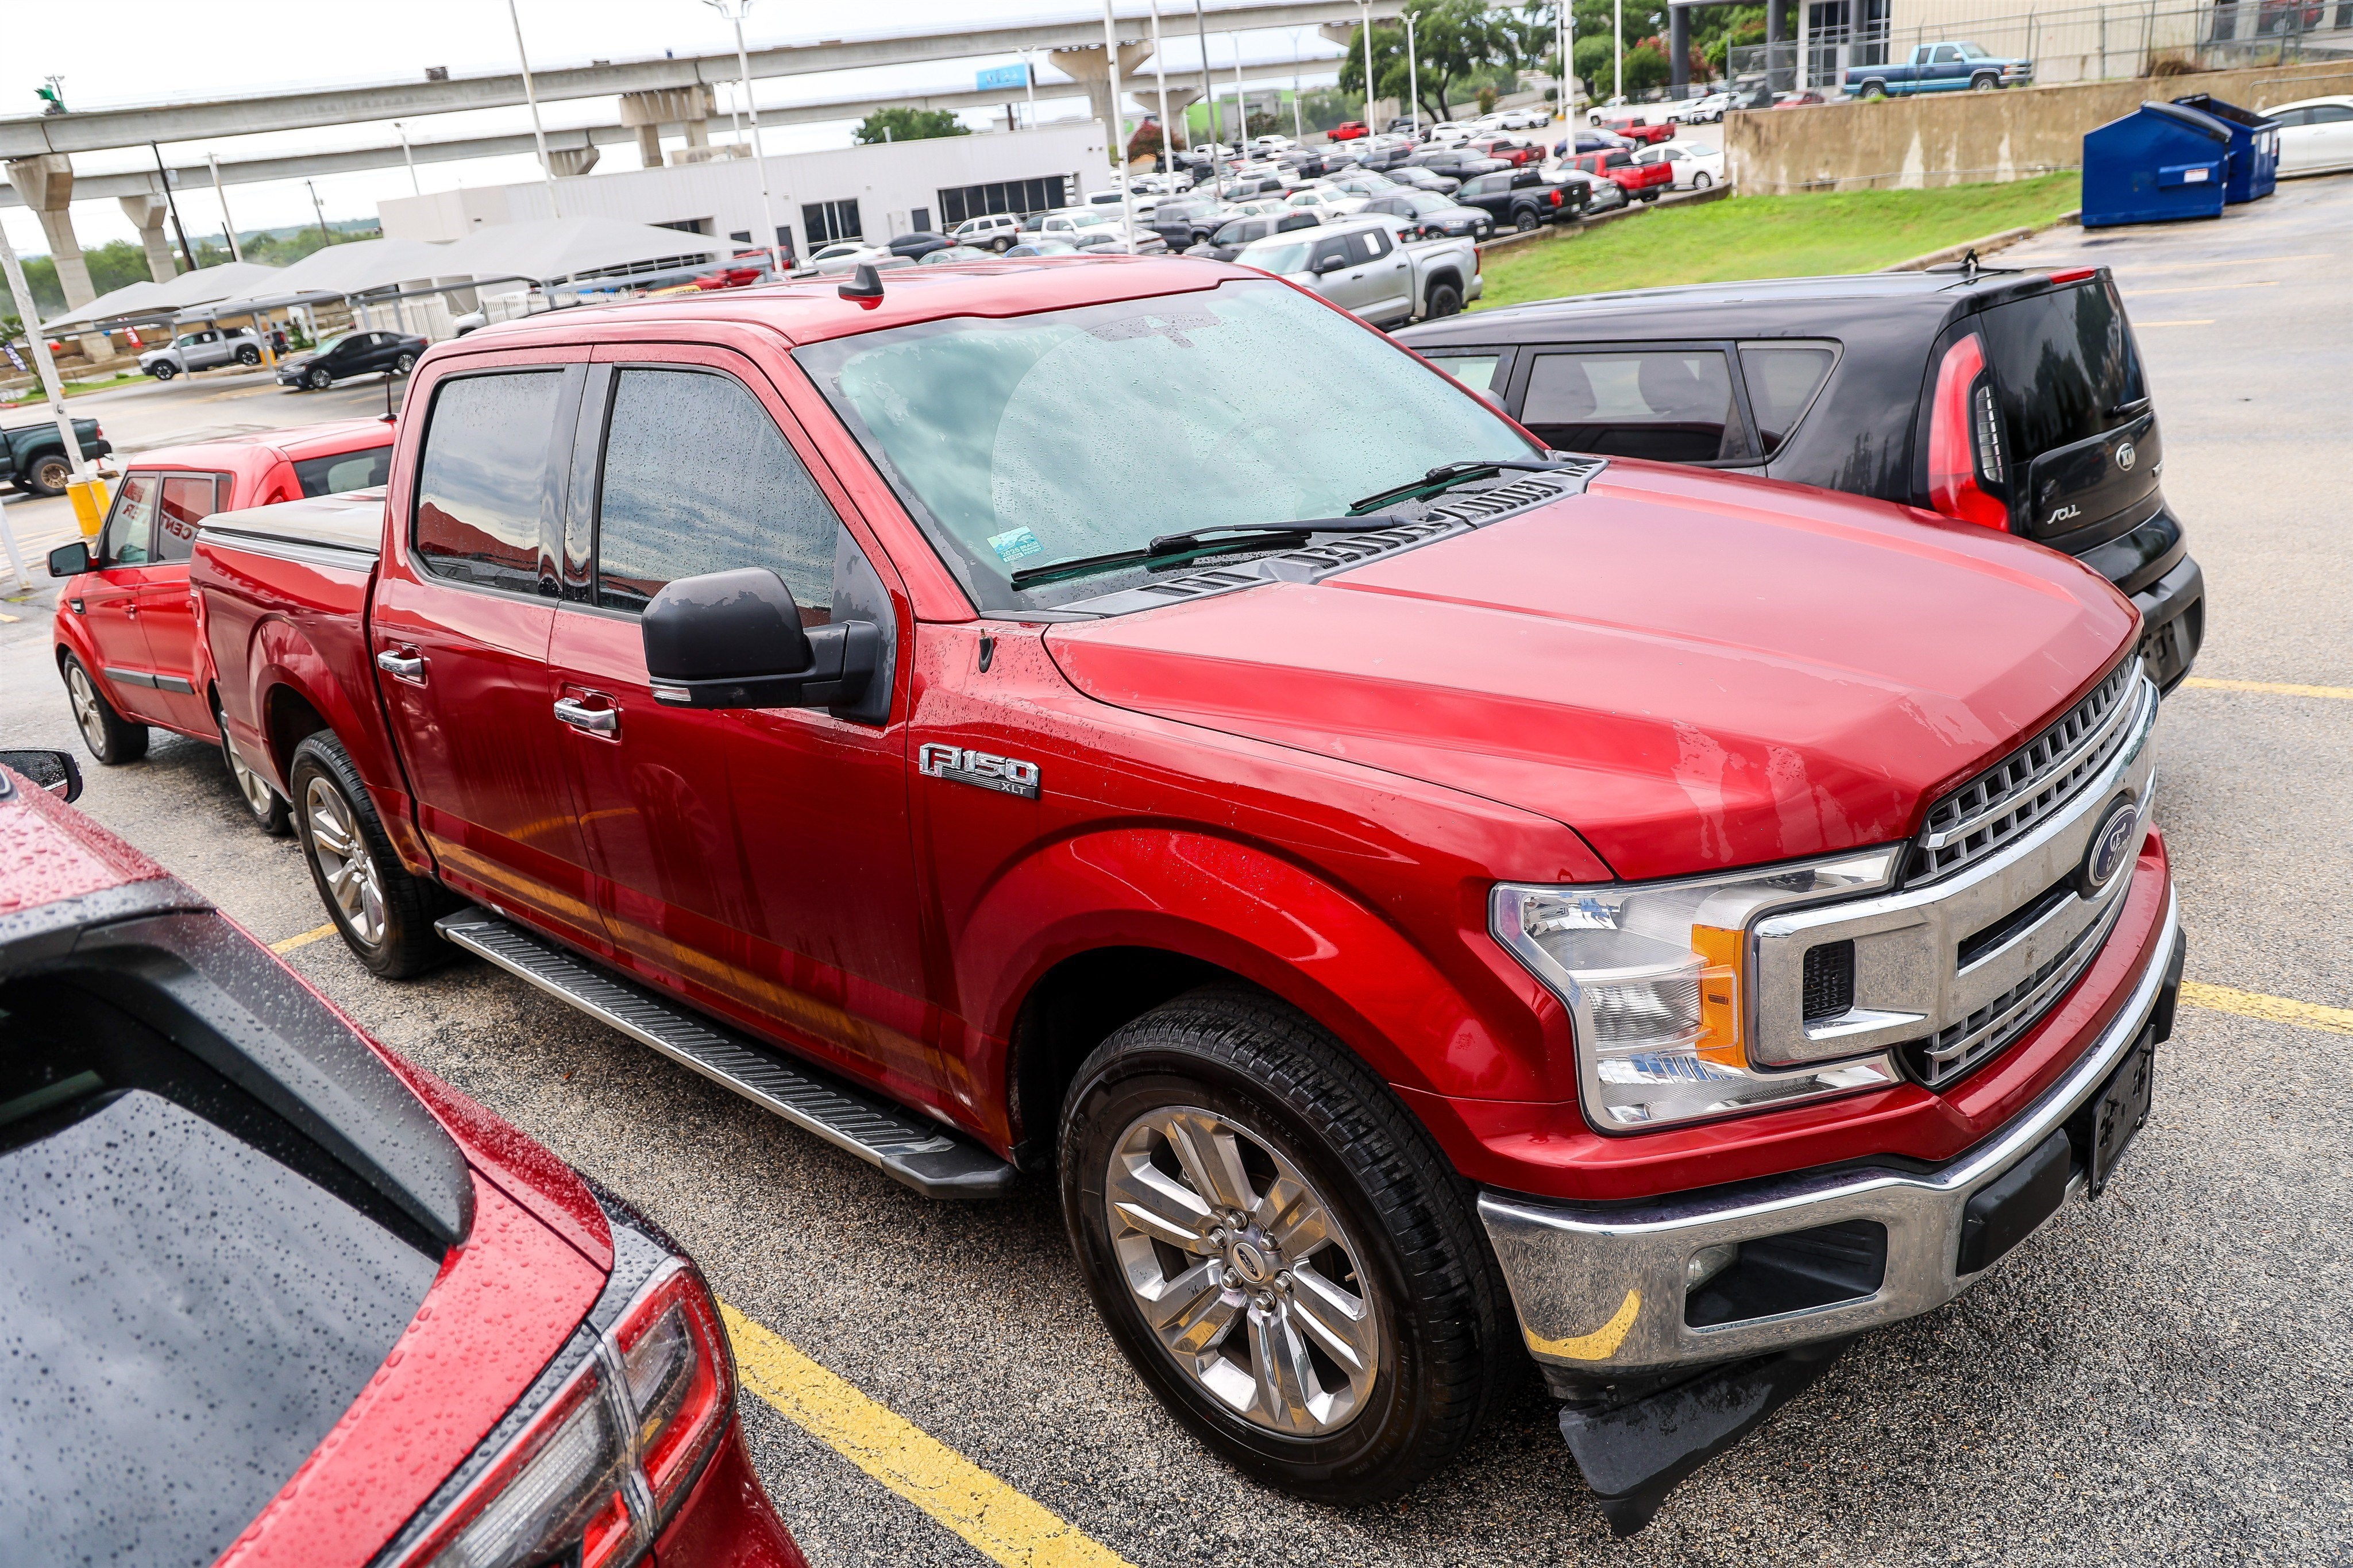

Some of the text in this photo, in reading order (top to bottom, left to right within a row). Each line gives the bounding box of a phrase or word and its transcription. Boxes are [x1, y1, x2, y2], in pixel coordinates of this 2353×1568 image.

[1019, 541, 1038, 550] BEACH
[1001, 547, 1020, 558] 2025
[1000, 782, 1027, 795] XLT
[2105, 822, 2133, 872] Ford
